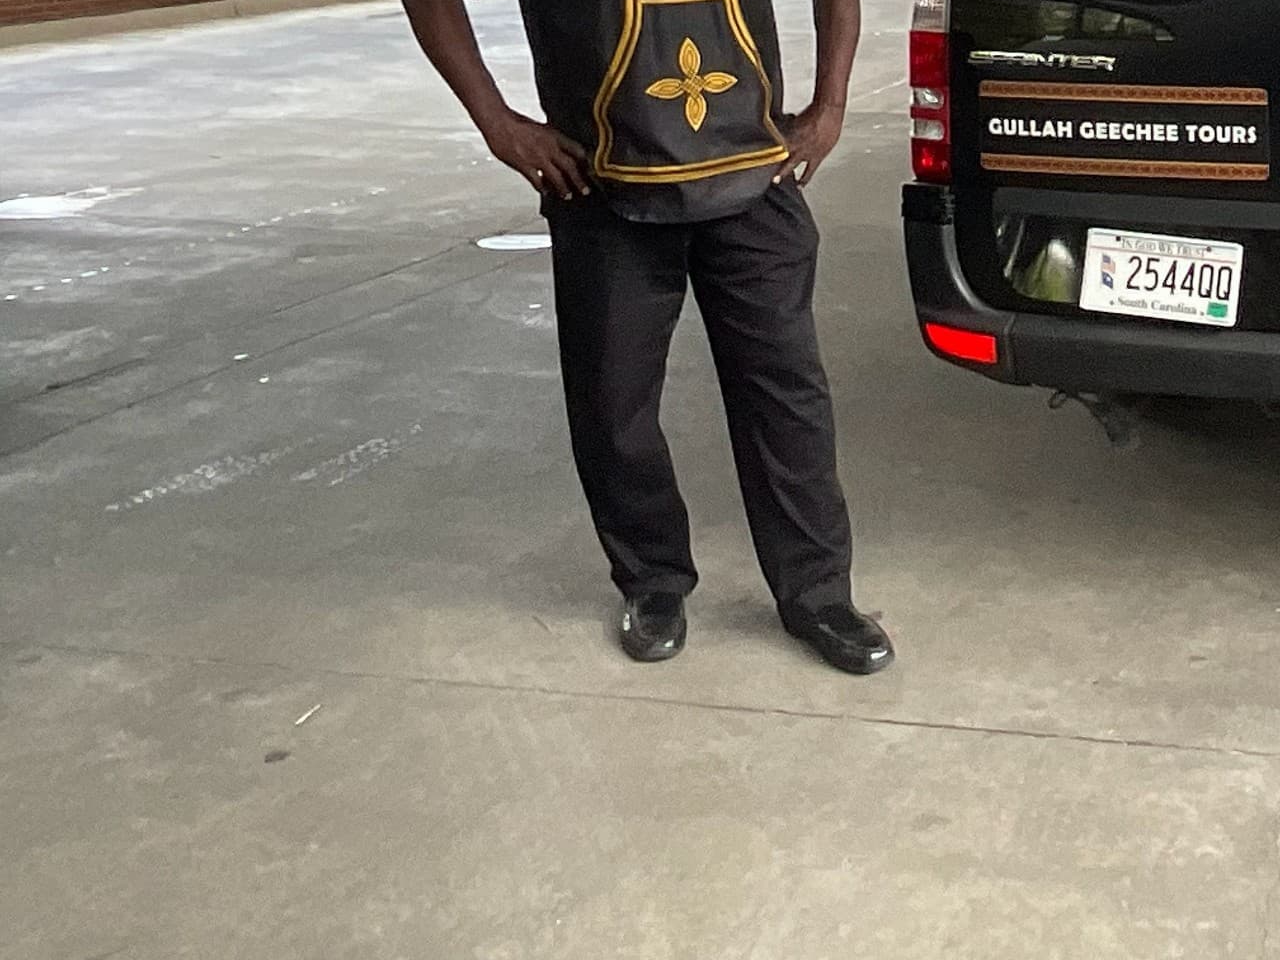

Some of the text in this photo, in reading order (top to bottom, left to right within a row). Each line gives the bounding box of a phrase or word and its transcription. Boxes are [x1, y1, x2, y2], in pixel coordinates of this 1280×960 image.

[988, 118, 1257, 144] GULLAH GEECHEE TOURS
[1117, 295, 1197, 315] South Carolina
